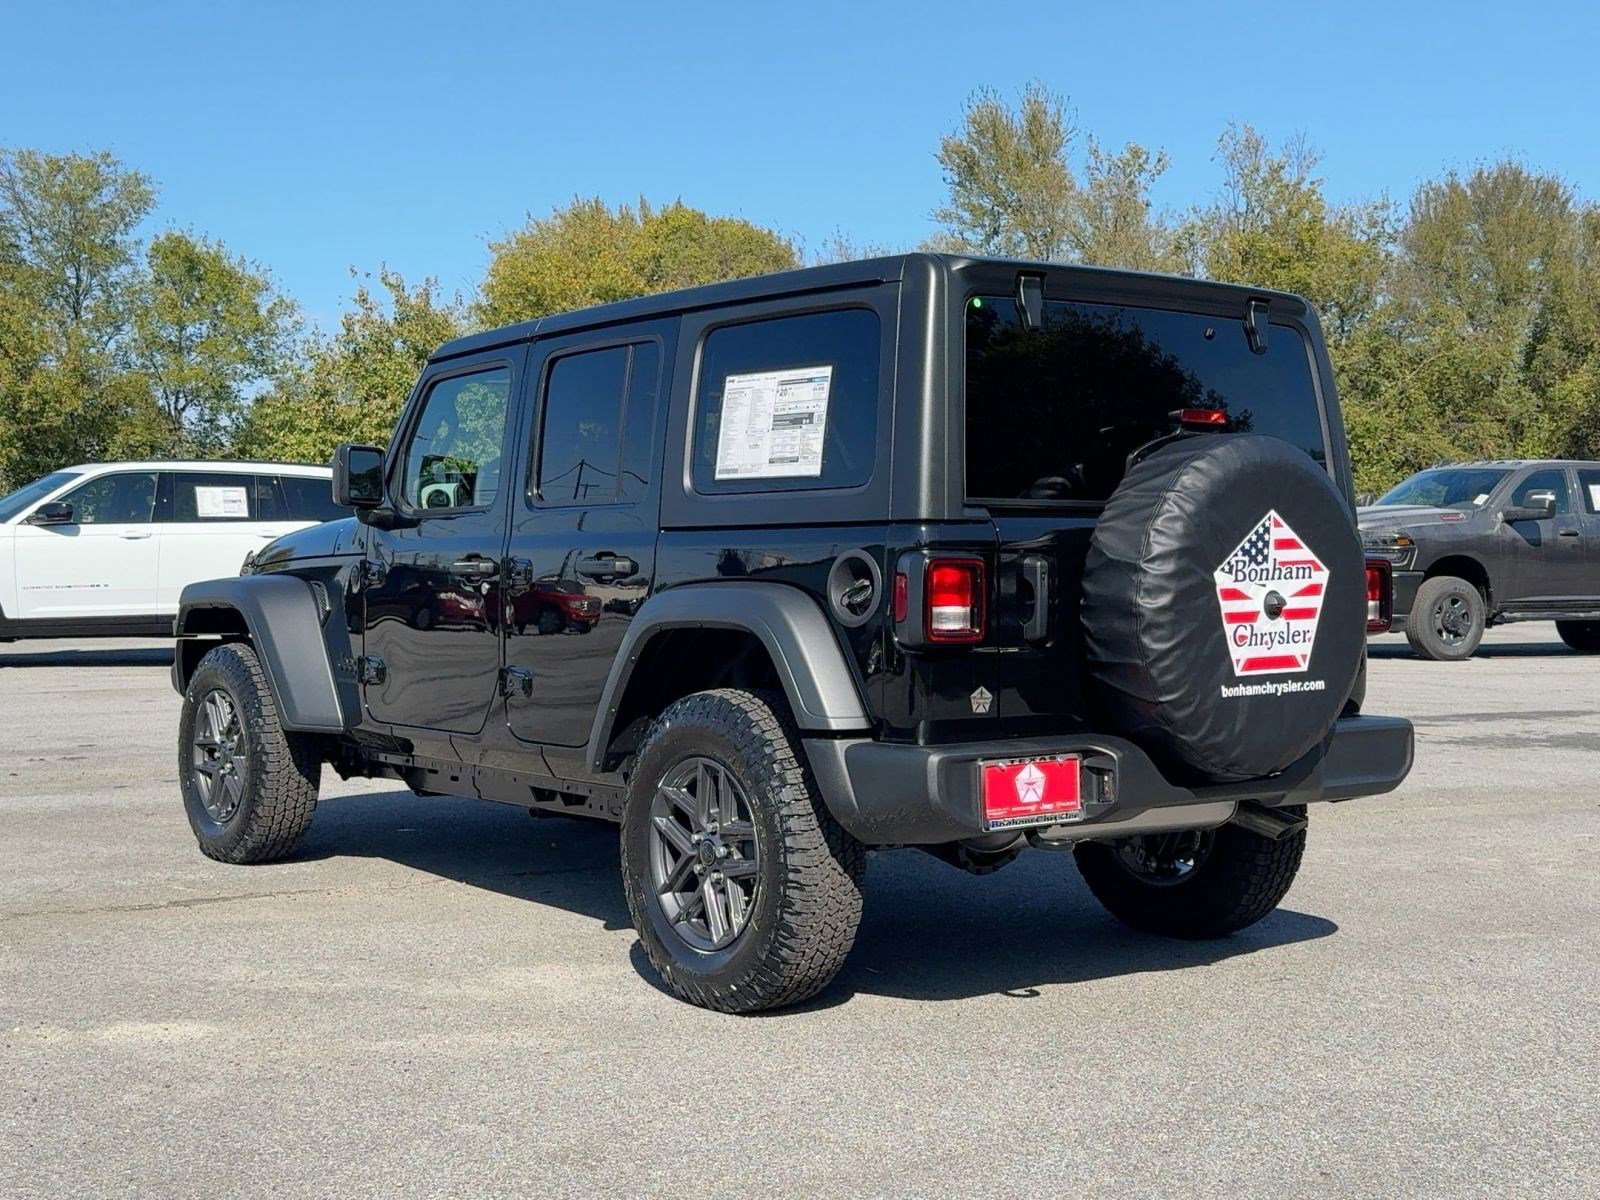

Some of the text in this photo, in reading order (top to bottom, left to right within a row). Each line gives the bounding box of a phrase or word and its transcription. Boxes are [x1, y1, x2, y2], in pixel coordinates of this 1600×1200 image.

[1233, 558, 1313, 583] Bonham
[1233, 622, 1310, 650] Chrysler
[1221, 679, 1325, 698] bonhamchrysler.com
